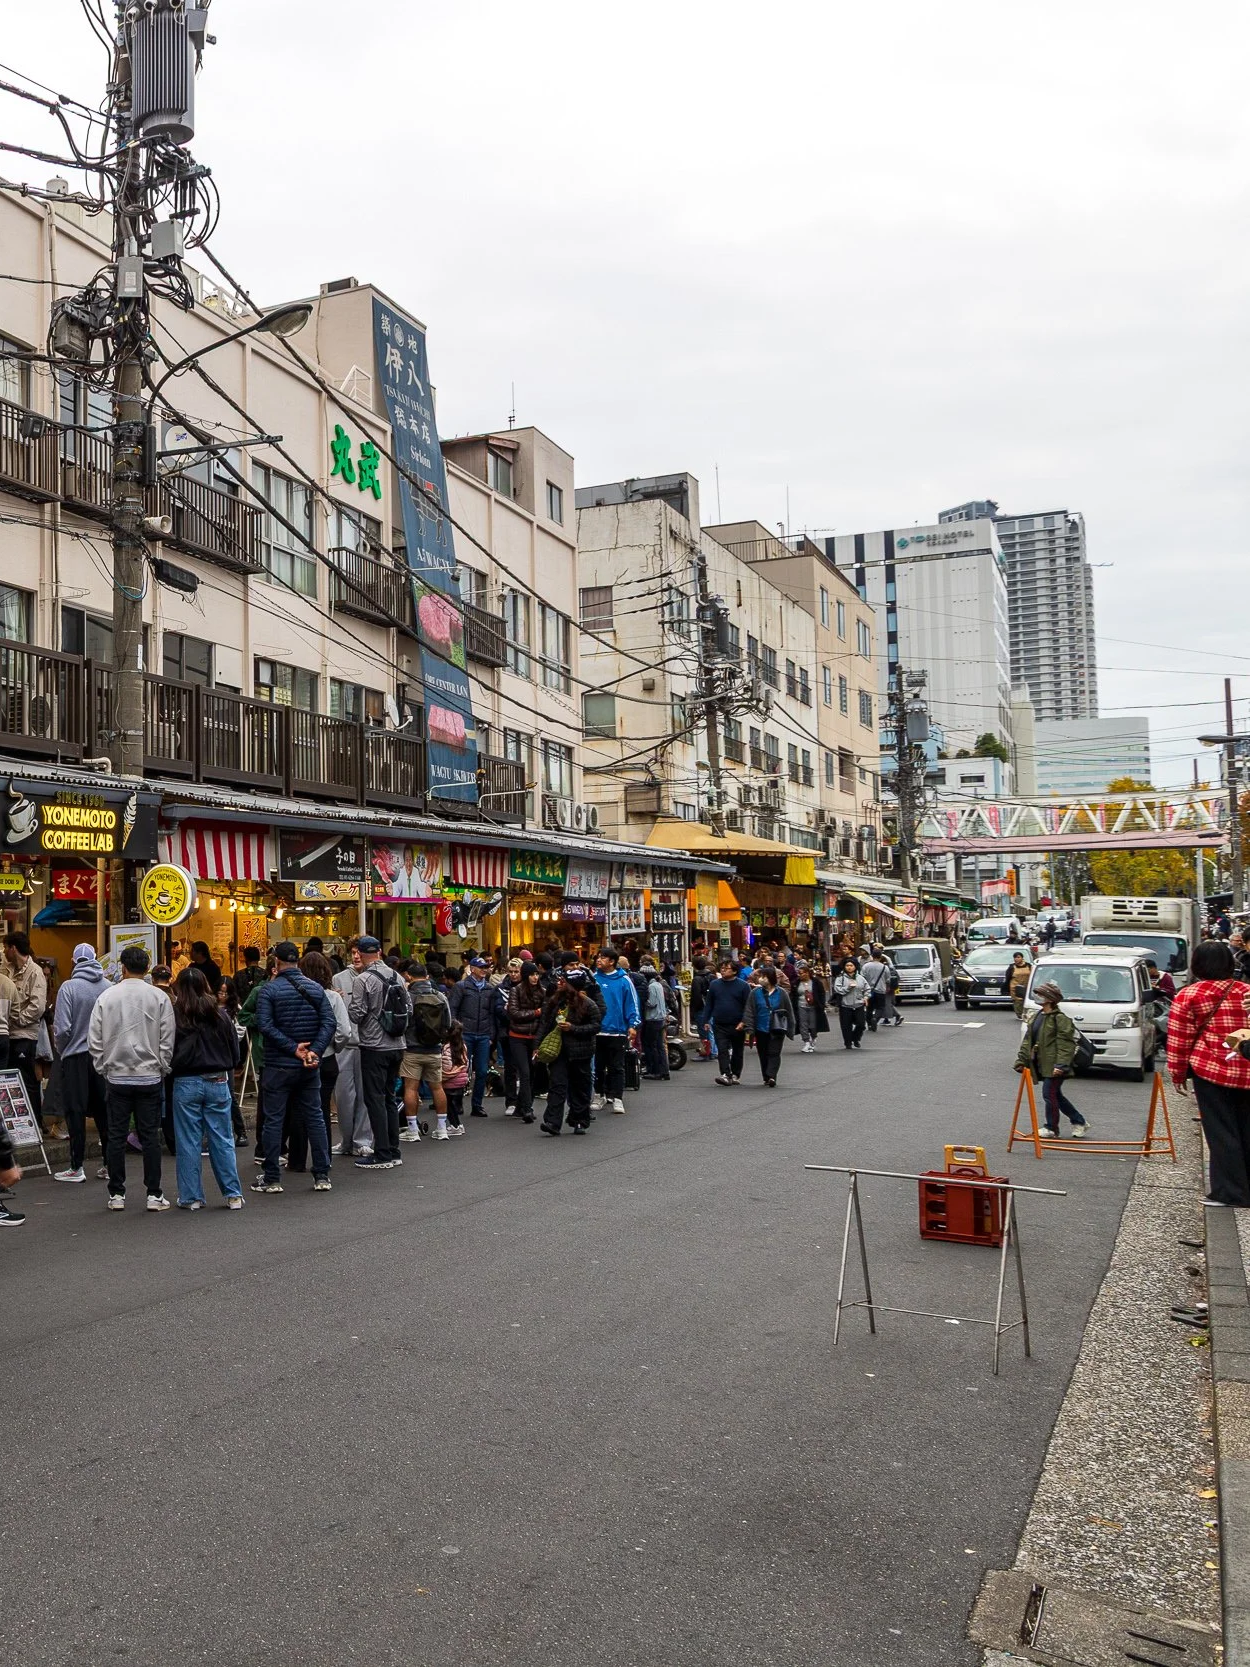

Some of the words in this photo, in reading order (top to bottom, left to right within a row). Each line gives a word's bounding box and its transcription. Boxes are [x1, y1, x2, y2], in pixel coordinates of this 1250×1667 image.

[330, 424, 382, 500] 丸武
[410, 445, 432, 469] Sirloin
[944, 530, 975, 539] HOTEL
[430, 764, 452, 780] WAGYU
[56, 791, 83, 805] SINCE
[42, 805, 116, 829] YONEMOTO
[42, 830, 90, 851] COFFEE
[90, 833, 114, 852] LAB
[325, 882, 371, 898] マーケト
